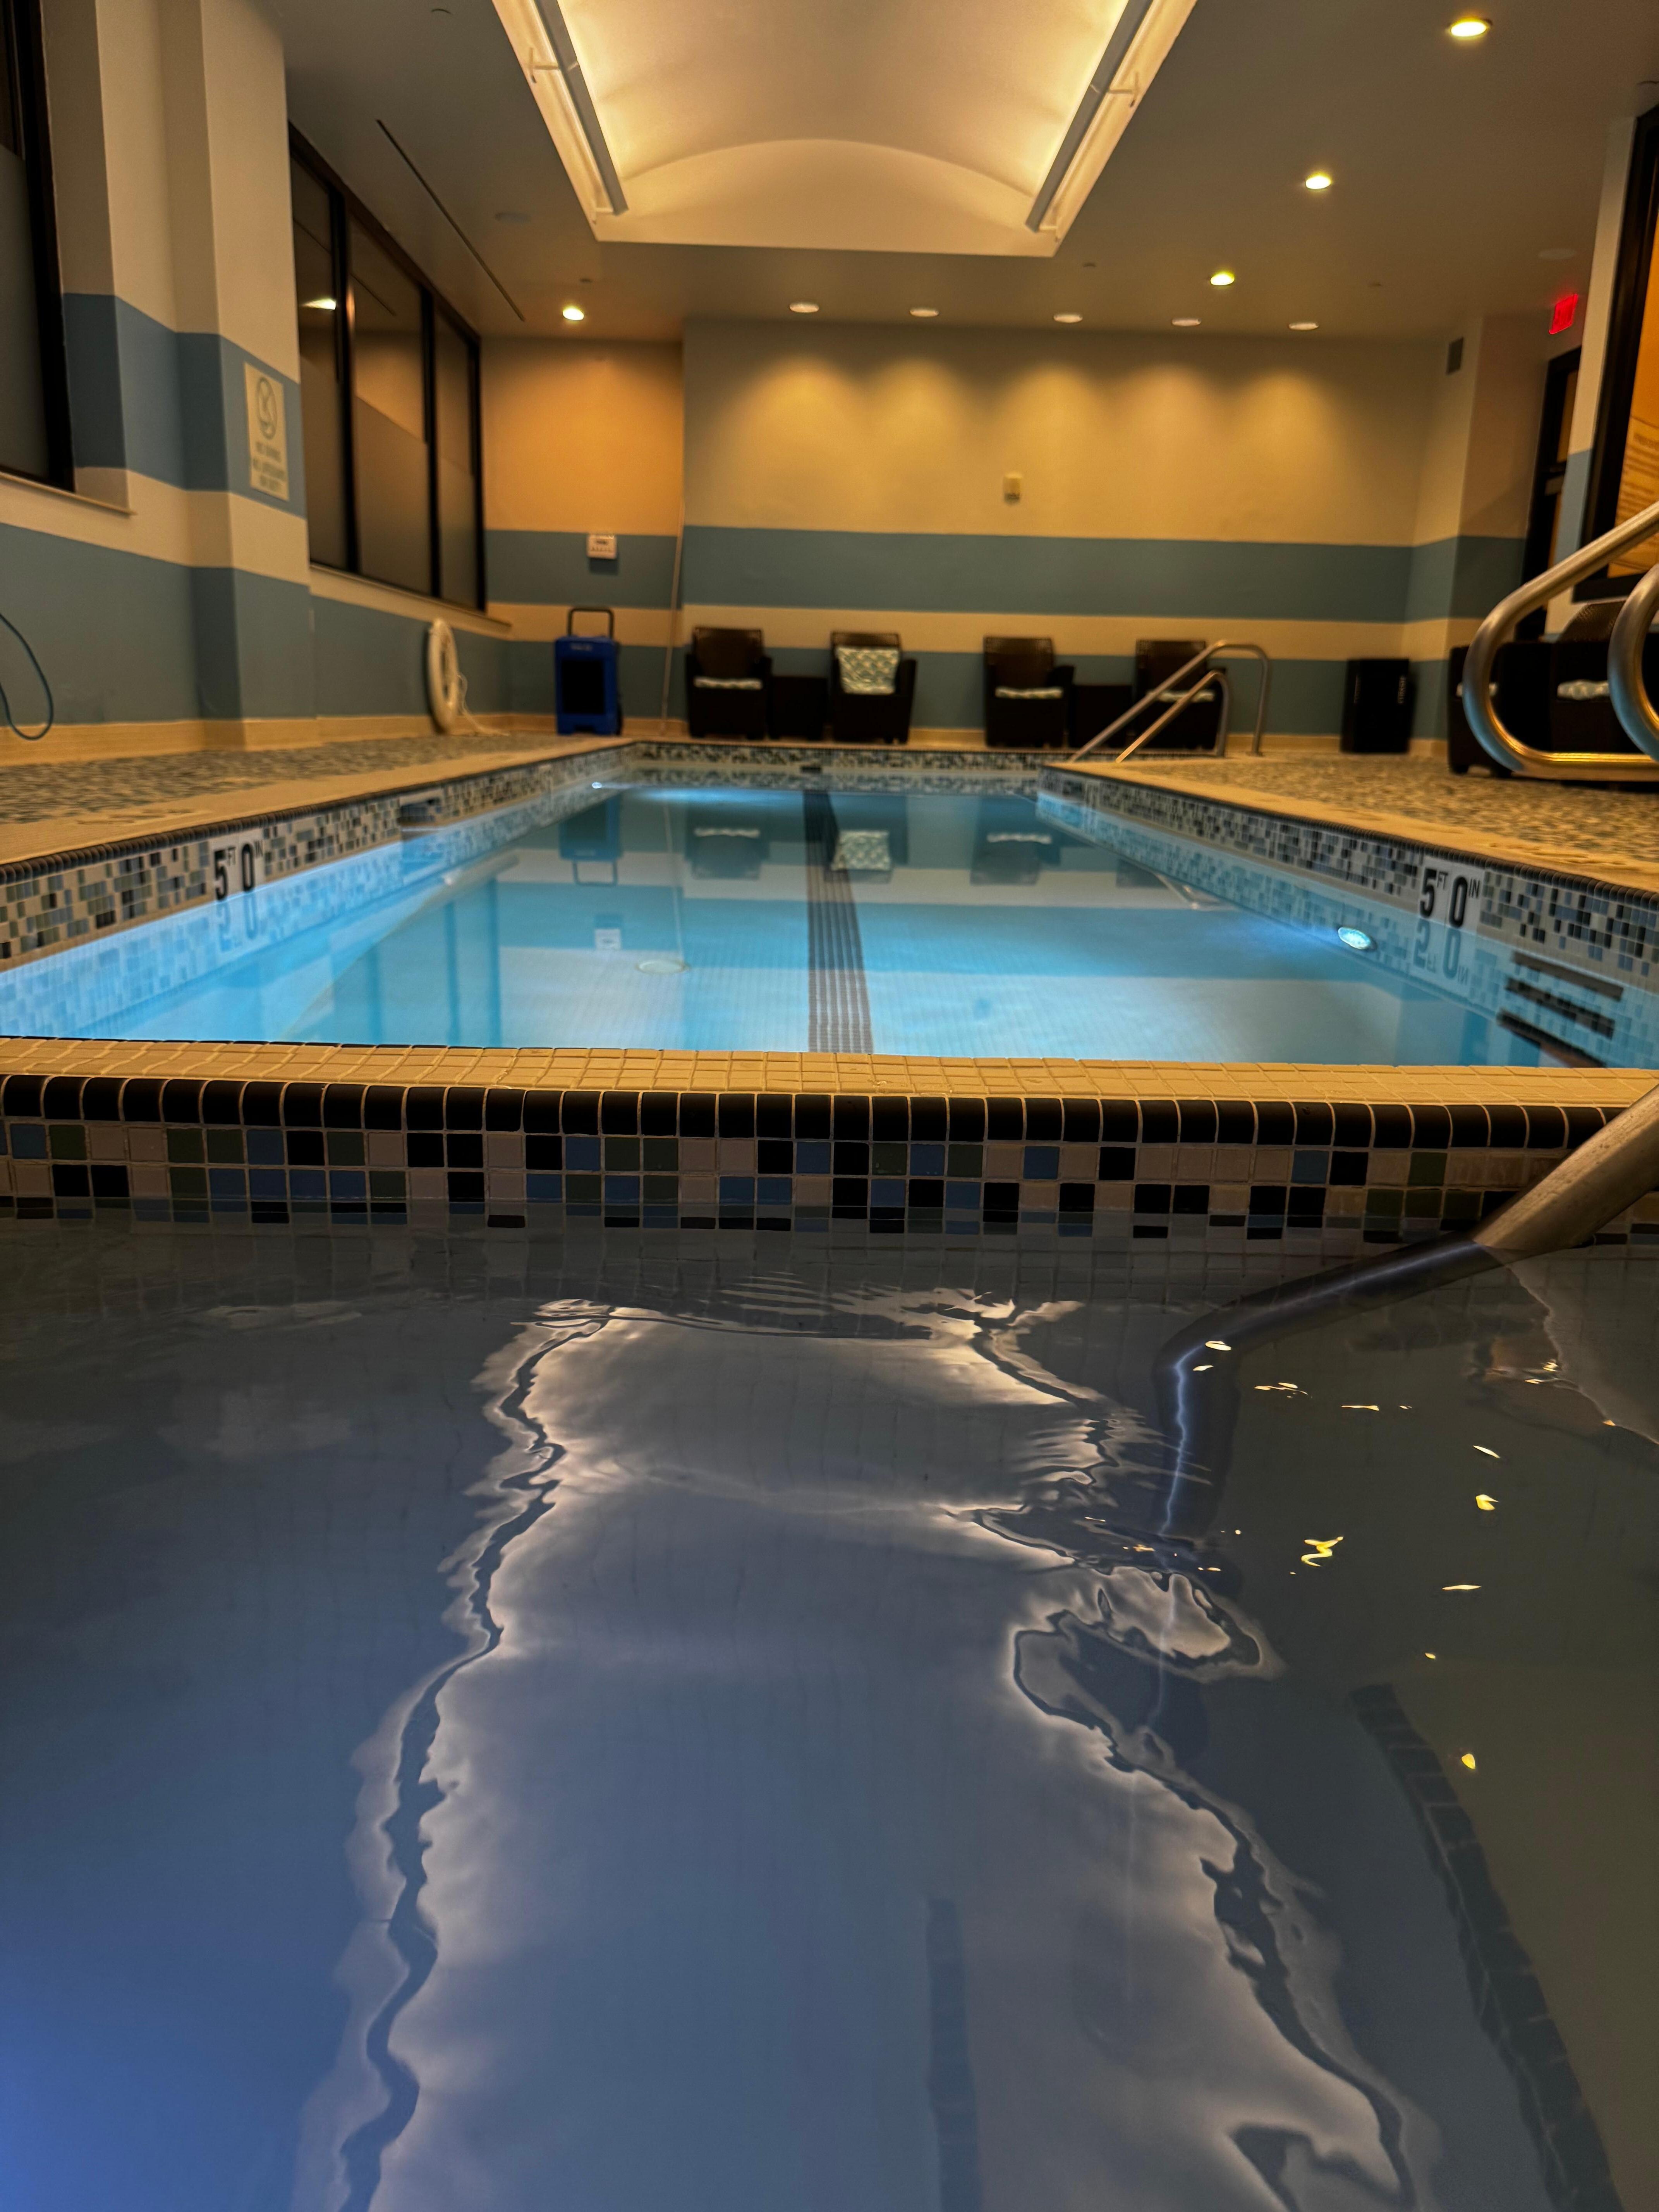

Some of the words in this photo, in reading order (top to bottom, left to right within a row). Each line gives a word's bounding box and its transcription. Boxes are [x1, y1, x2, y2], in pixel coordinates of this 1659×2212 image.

[214, 849, 228, 902] 5
[242, 843, 254, 892] 0
[1419, 868, 1437, 918] 5
[1437, 871, 1448, 890] FT
[1449, 876, 1468, 928] 0
[1468, 879, 1480, 899] IN
